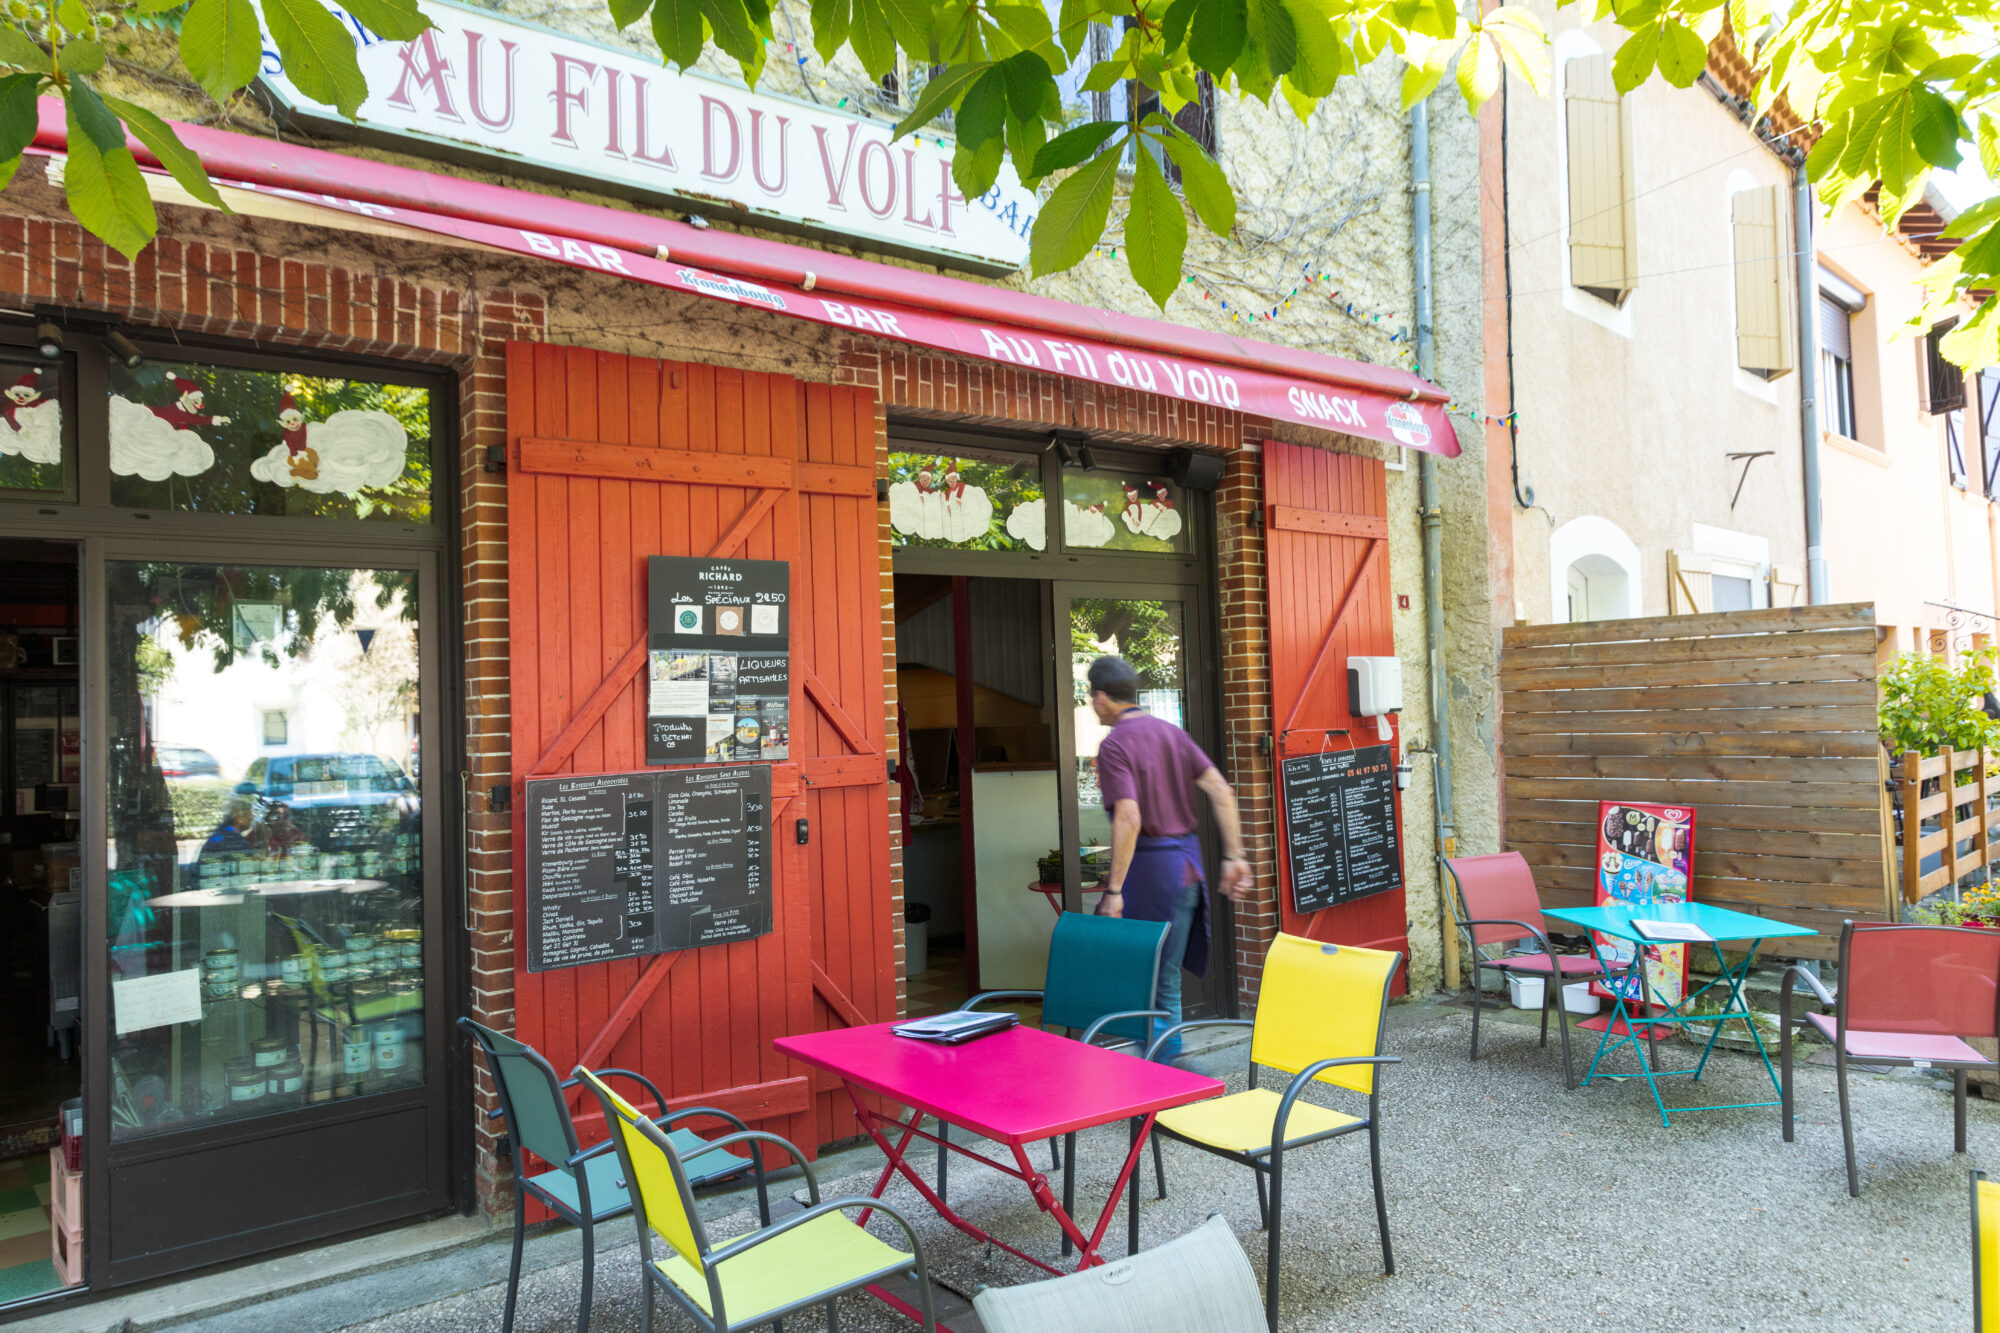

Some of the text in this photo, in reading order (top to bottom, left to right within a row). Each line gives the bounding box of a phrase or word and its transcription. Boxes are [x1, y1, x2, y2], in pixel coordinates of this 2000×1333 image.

[387, 28, 520, 132] AU
[548, 53, 676, 171] FIL
[699, 96, 788, 195] DU
[811, 122, 966, 234] VOLP
[520, 231, 786, 308] BAR Kronenbourg
[819, 298, 907, 338] BAR
[980, 328, 1368, 428] Au Fil du Volp SNACK
[699, 572, 743, 582] RICHARD
[671, 592, 694, 603] Les
[1401, 597, 1408, 607] 4
[739, 658, 787, 670] LIQUEURS
[1348, 769, 1354, 777] 05
[542, 860, 573, 868] Kronenbourg
